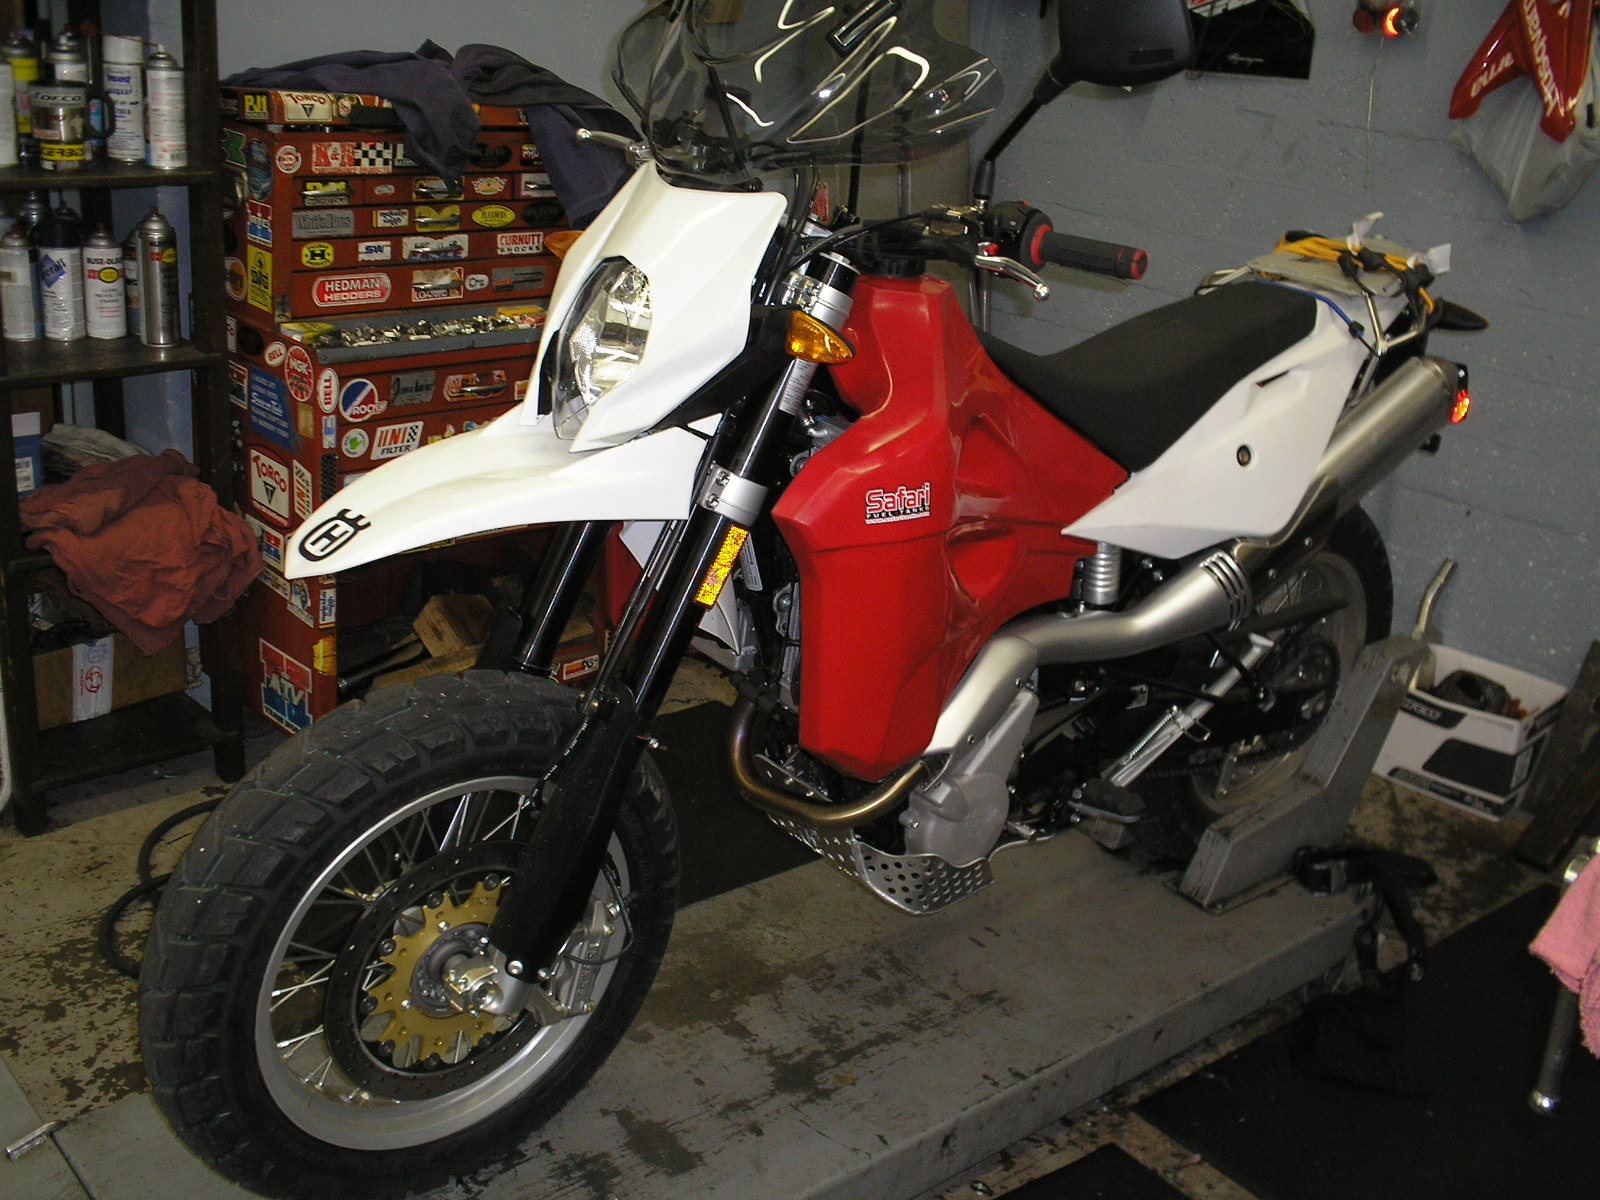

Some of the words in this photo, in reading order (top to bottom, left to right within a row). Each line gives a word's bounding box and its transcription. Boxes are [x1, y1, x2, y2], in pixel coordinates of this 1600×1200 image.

[244, 94, 268, 113] PJ1
[286, 93, 326, 105] TORCO
[499, 234, 542, 246] CURNUTT
[500, 245, 541, 254] SHOCKS
[325, 278, 381, 292] HEDMAN
[324, 290, 382, 302] HEDDERS
[324, 375, 333, 406] BELL
[381, 444, 411, 456] FILTER
[253, 455, 287, 493] TORCO
[865, 482, 931, 514] Safari
[866, 511, 895, 519] FUEL
[899, 505, 930, 515] TANKS
[270, 672, 305, 707] ATV
